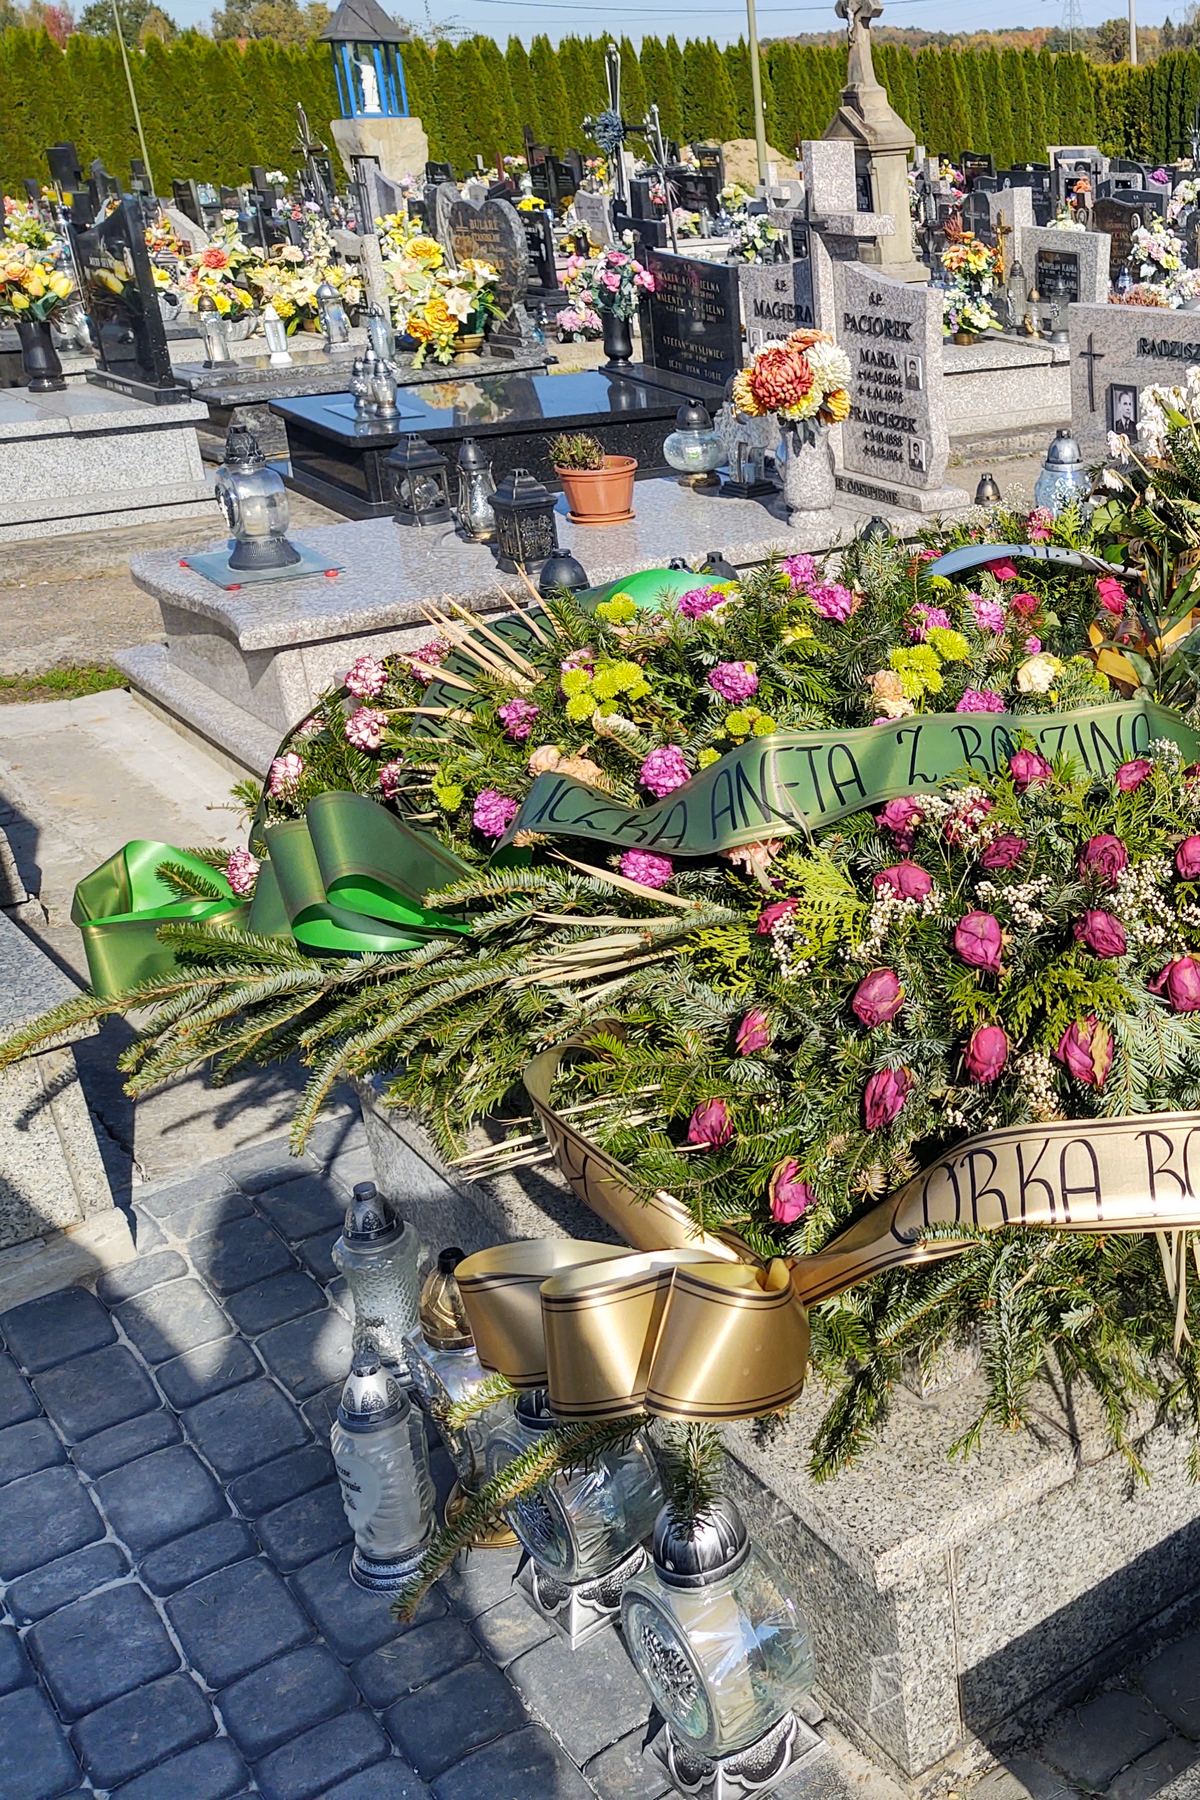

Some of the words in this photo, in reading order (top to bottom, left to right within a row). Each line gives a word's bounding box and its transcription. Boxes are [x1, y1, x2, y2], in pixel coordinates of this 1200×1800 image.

[753, 299, 814, 323] MAGIERA
[843, 312, 914, 342] PACIOREK
[860, 347, 899, 370] MARIA
[850, 405, 919, 434] FRANCISZEK
[710, 743, 866, 842] ANETA
[895, 724, 938, 786] Z
